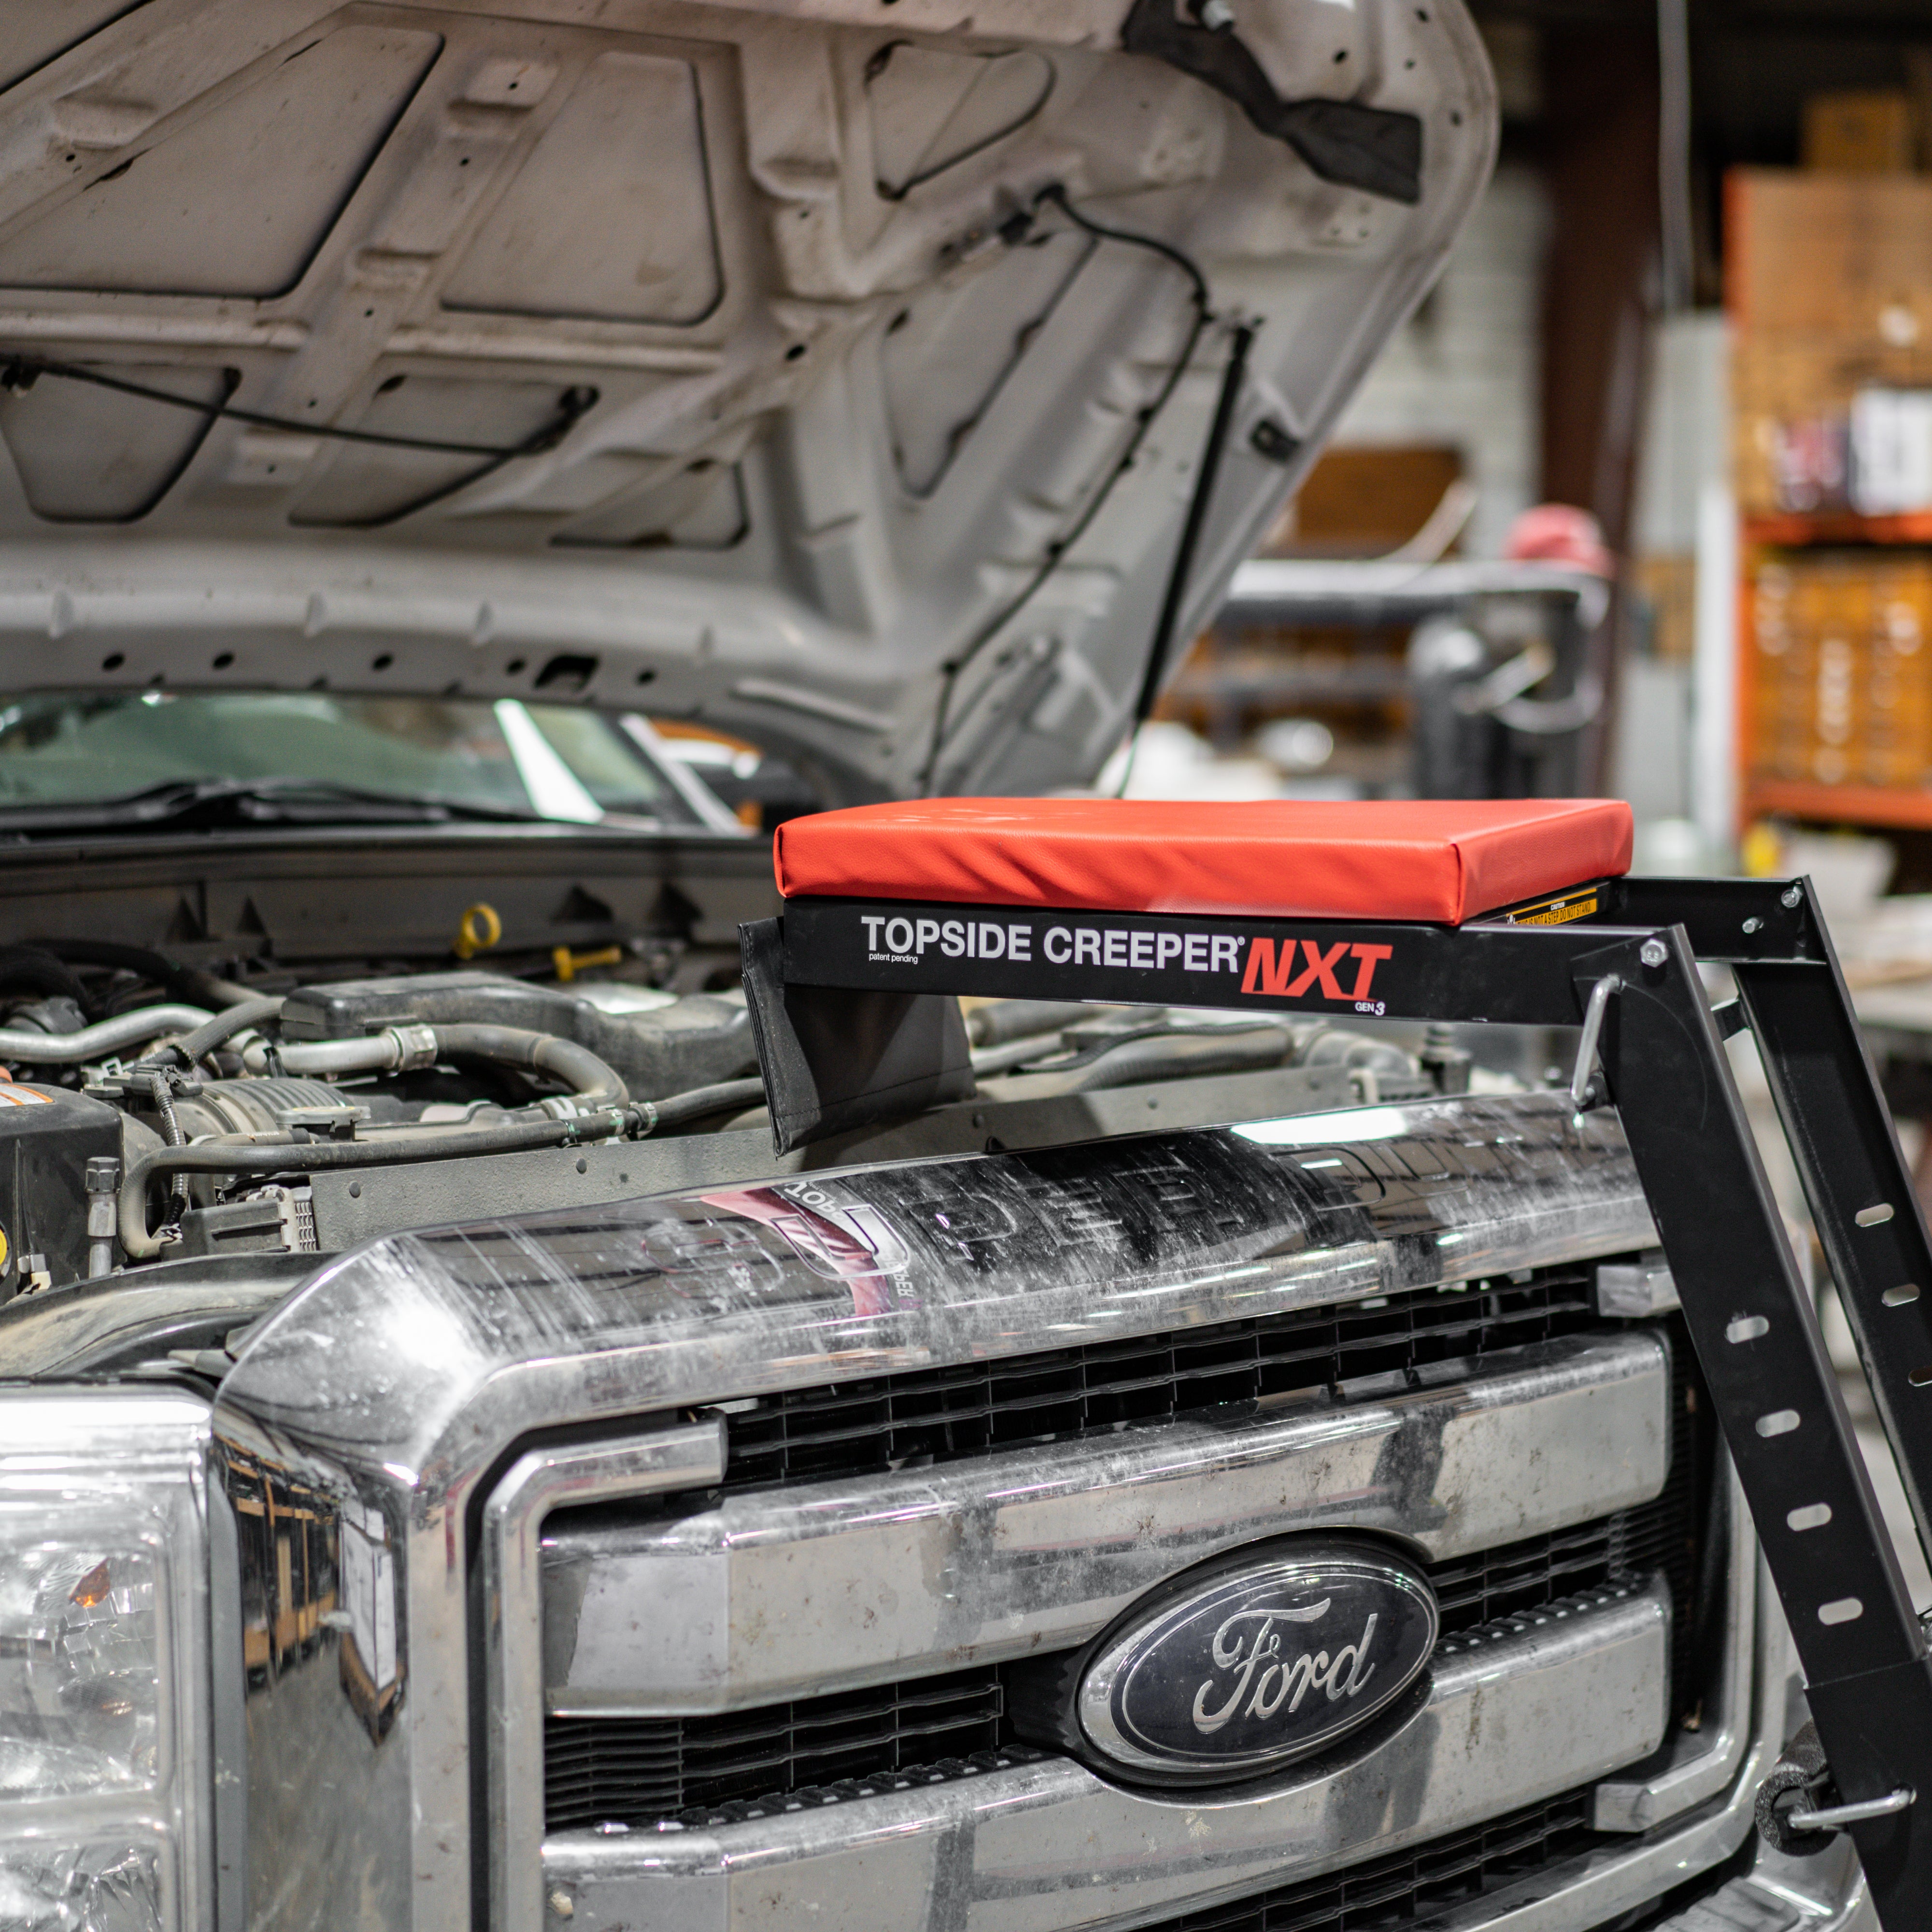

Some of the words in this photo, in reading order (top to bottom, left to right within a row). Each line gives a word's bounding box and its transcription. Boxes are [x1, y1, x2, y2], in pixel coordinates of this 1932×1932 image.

[1551, 901, 1565, 911] CAUTION
[1560, 909, 1566, 921] DO
[1567, 906, 1576, 919] NOT
[861, 916, 1032, 961] TOPSIDE
[1241, 937, 1393, 1002] NXT
[869, 953, 890, 961] patent
[891, 954, 918, 965] pending
[1355, 1001, 1375, 1012] GEN
[1375, 1001, 1386, 1016] 3
[1193, 1597, 1378, 1734] Ford
